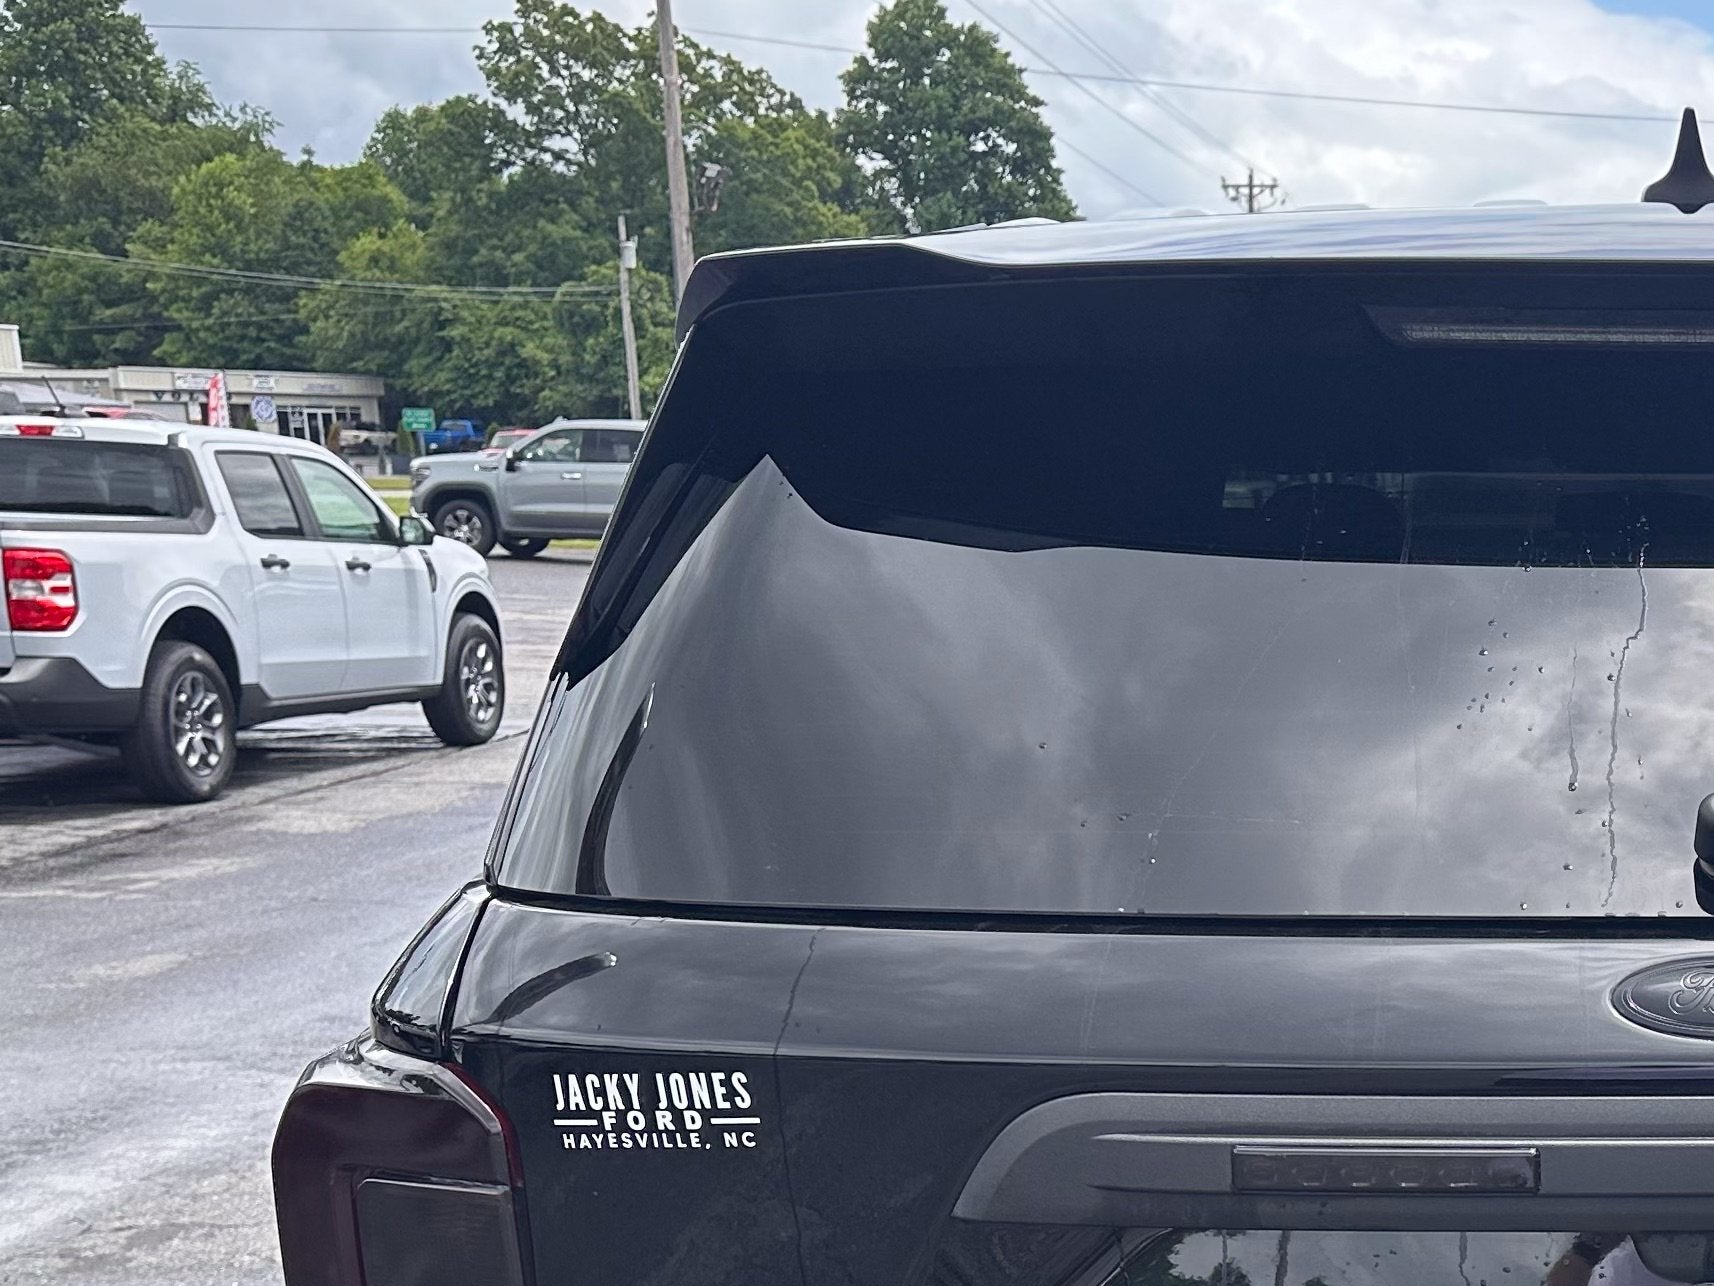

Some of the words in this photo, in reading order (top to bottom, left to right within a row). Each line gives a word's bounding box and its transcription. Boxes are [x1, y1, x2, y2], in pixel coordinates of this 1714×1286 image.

[553, 1073, 641, 1111] JACKY
[655, 1071, 752, 1110] JONES
[602, 1110, 703, 1131] FORD
[563, 1133, 711, 1150] HAYESVILLE,
[723, 1131, 757, 1148] NC
